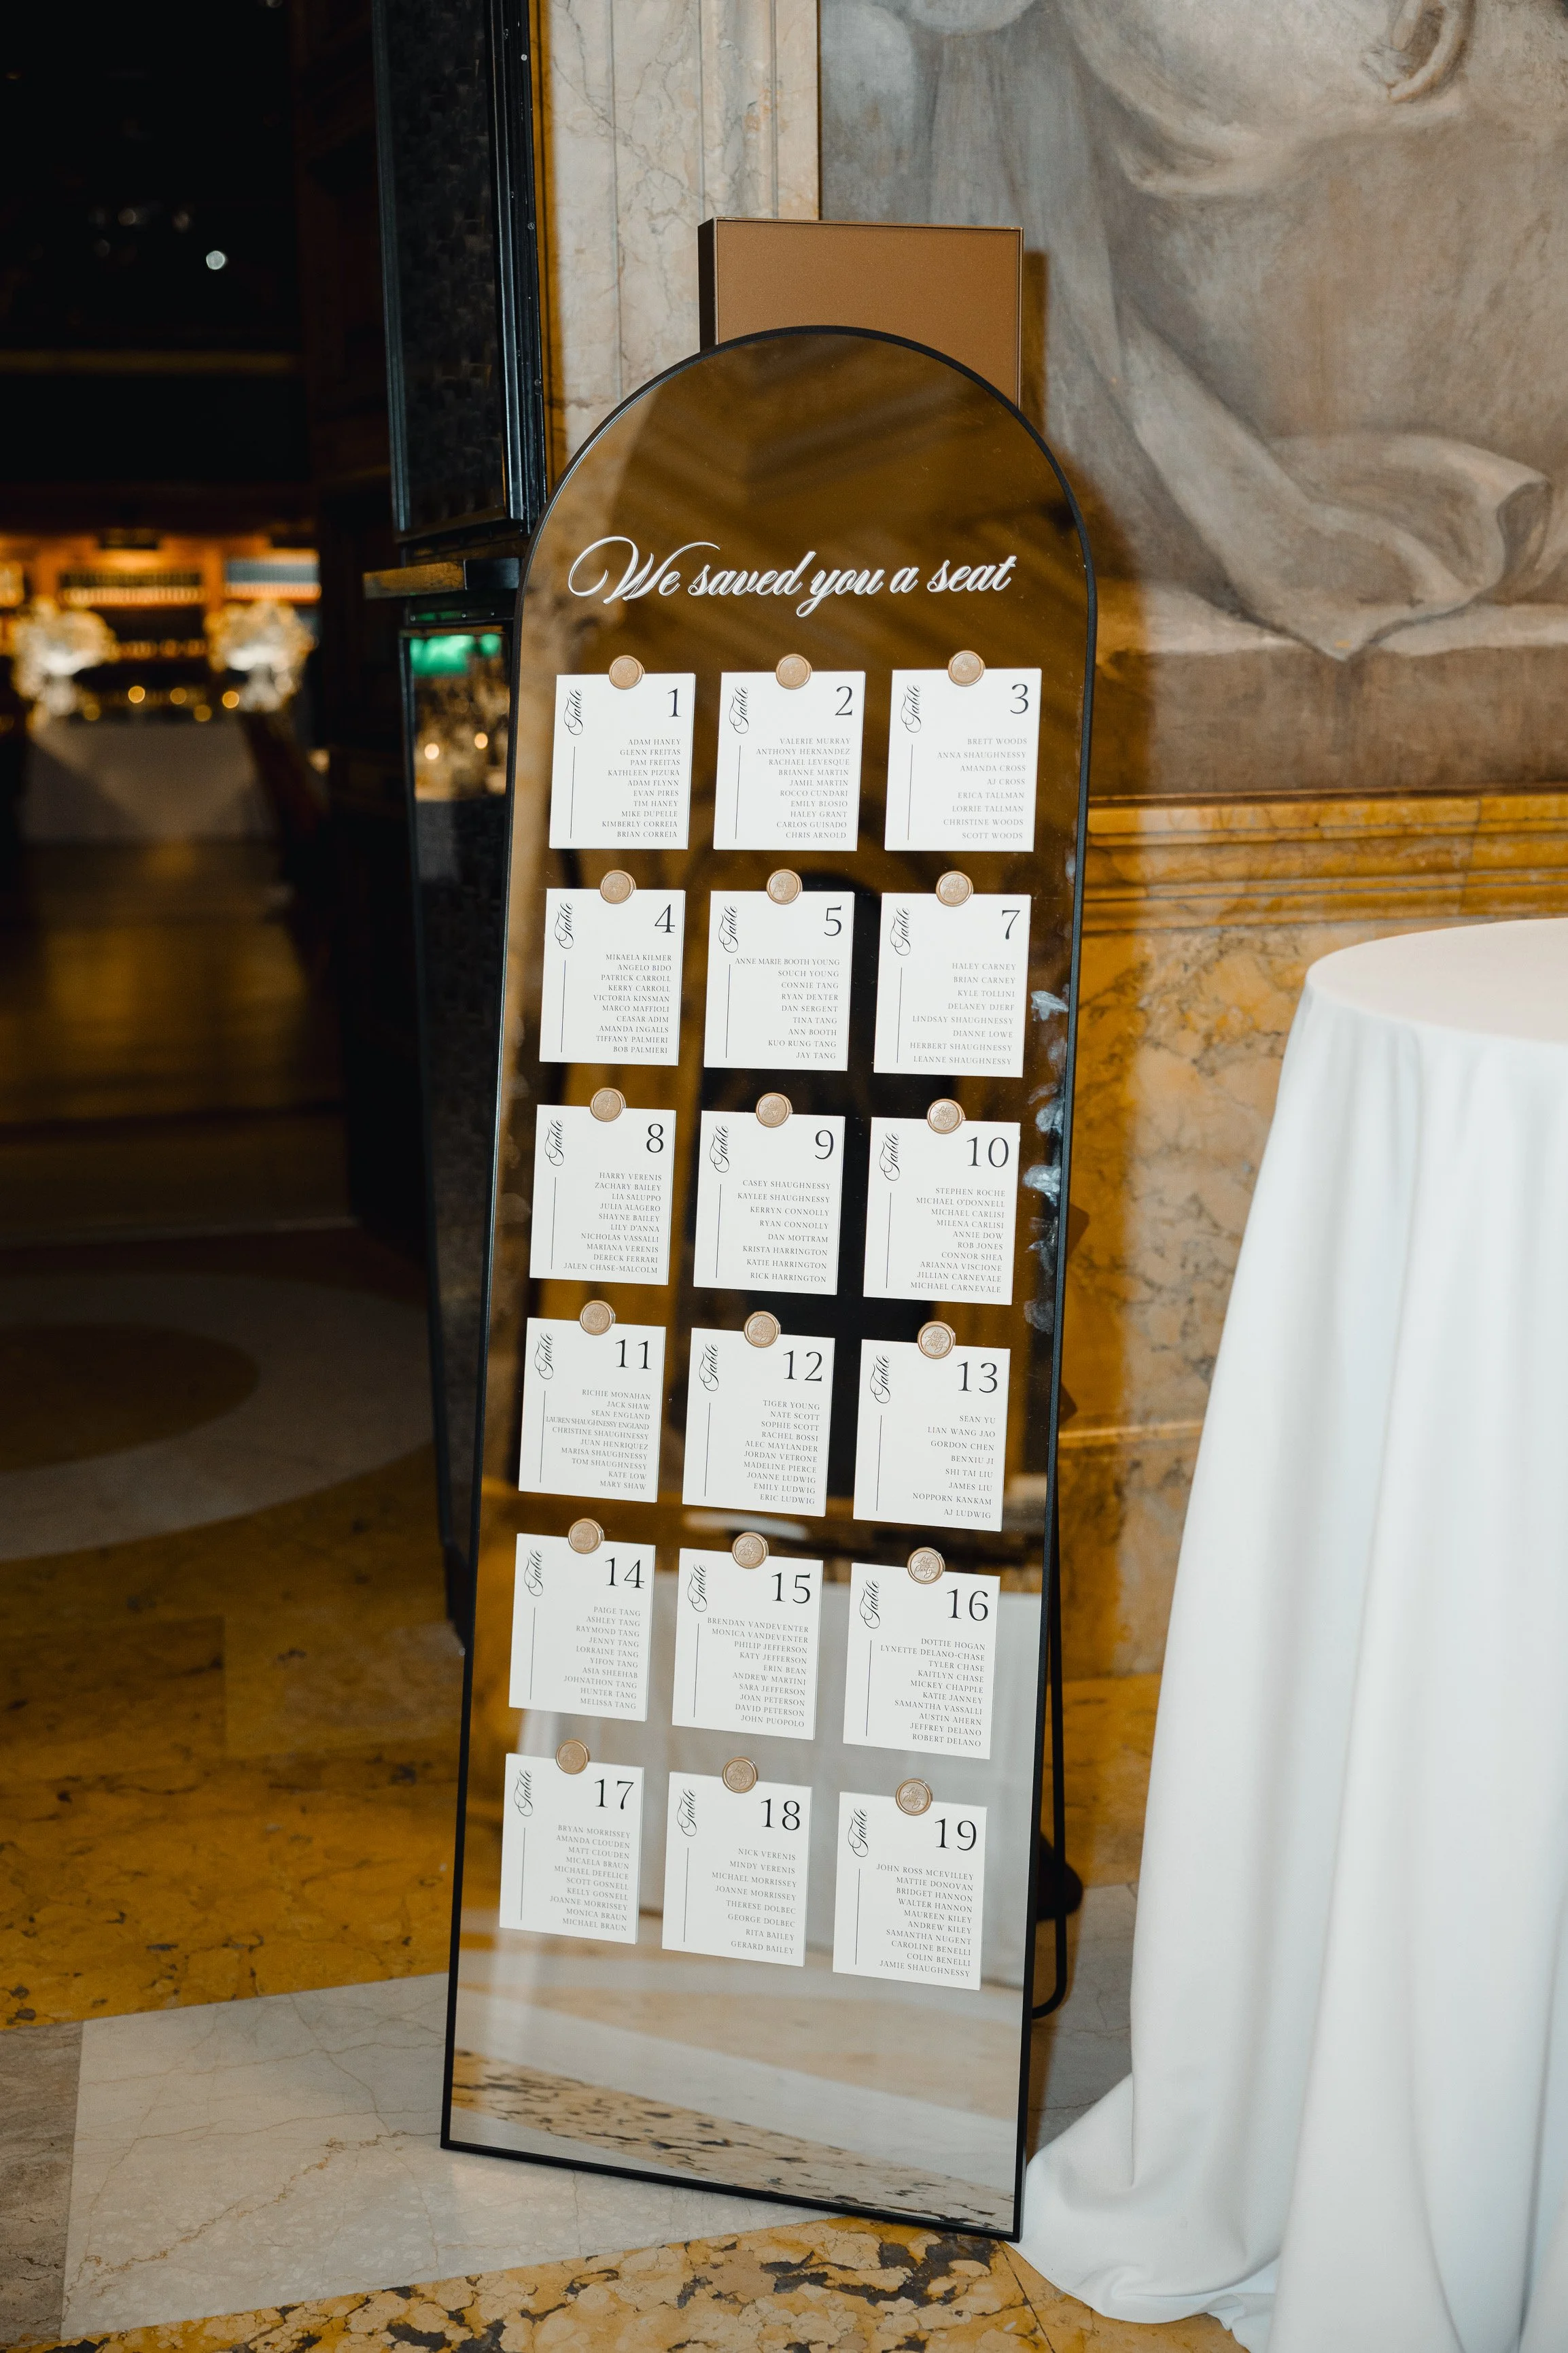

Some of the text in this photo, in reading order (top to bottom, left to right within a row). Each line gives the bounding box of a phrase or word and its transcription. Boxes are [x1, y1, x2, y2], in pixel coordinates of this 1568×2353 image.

[568, 536, 1018, 618] We saved you a seat
[667, 688, 682, 717] 1
[835, 686, 853, 716] 2
[1010, 683, 1029, 715] 3
[563, 689, 583, 736] Table
[729, 687, 749, 734] Table
[901, 685, 922, 733] Table
[995, 737, 1028, 745] WOODS
[943, 818, 1024, 826] CHRISTINE WOODS
[554, 903, 574, 949] Table
[654, 904, 676, 933] 4
[824, 905, 842, 937] 5
[1001, 910, 1021, 940] 7
[718, 906, 739, 953] Table
[890, 908, 911, 956] Table
[812, 958, 840, 966] YOUNG
[953, 976, 1015, 984] BRIAN CARNEY
[912, 1015, 1014, 1025] LINDSAY SHAUGHNESSY
[953, 1029, 1013, 1039] DIANNE LOWE
[544, 1120, 564, 1167] Table
[646, 1123, 664, 1153] 8
[815, 1129, 834, 1160] 9
[709, 1125, 730, 1173] Table
[966, 1136, 1009, 1168] 10
[879, 1133, 901, 1182] Table
[599, 1171, 662, 1182] HARRY VERENIS
[594, 1182, 661, 1192] ZACHARY BAILEY
[935, 1187, 1005, 1197] STEPHEN ROCHE
[737, 1192, 830, 1203] KAYLEE SHAUGHNESSY
[759, 1220, 829, 1230] RYAN CONNOLLY
[580, 1233, 659, 1243] NICHOLAS VASSALLI
[976, 1242, 1003, 1250] JONES
[771, 1273, 826, 1283] HARRINGTON
[910, 1281, 1001, 1293] MICHAEL CARNEVALE
[534, 1333, 554, 1380] Table
[615, 1339, 652, 1370] 11
[699, 1343, 719, 1392] Table
[783, 1350, 822, 1382] 12
[869, 1355, 891, 1404] Table
[957, 1361, 998, 1393] 13
[582, 1388, 651, 1401] RICHIE MONAHAN
[763, 1399, 820, 1411] TIGER YOUNG
[959, 1415, 996, 1424] SEAN YU
[761, 1430, 818, 1442] RACHEL BOSSI
[580, 1438, 648, 1450] JUAN HENRIQUEZ
[930, 1440, 994, 1452] GORDON CHEN
[572, 1457, 647, 1471] TOM SHAUGHNESSY
[746, 1471, 816, 1484] JOANNE LUDWIG
[912, 1492, 992, 1506] NOPPORN KANKAM
[524, 1549, 544, 1597] Table
[605, 1557, 645, 1590] 14
[687, 1564, 708, 1613] Table
[771, 1572, 811, 1604] 15
[593, 1606, 641, 1617] PAIGE TANG
[859, 1580, 880, 1629] Table
[947, 1588, 988, 1621] 16
[576, 1625, 640, 1638] RAYMOND TANG
[707, 1617, 809, 1633] BRENDAN VANDEVENTER
[921, 1638, 986, 1651] DOTTIE HOGAN
[739, 1651, 807, 1664] KATY JEFFERSON
[563, 1675, 638, 1689] JOHNATHON TANG
[918, 1669, 984, 1683] KAITLYN CHASE
[735, 1703, 805, 1717] DAVID PETERSON
[912, 1733, 981, 1747] ROBERT DELANO
[514, 1770, 534, 1817] Table
[594, 1779, 635, 1810] 17
[677, 1789, 697, 1837] Table
[761, 1798, 800, 1831] 18
[557, 1824, 631, 1839] BRYAN MORRISSEY
[848, 1808, 869, 1857] Table
[935, 1818, 977, 1851] 19
[738, 1848, 796, 1861] NICK VERENIS
[565, 1876, 629, 1891] SCOTT GOSNELL
[896, 1887, 973, 1902] BRIDGET HANNON
[727, 1913, 796, 1928] GEORGE DOLBEC
[904, 1909, 972, 1924] MAUREEN KILEY
[886, 1929, 972, 1945] SAMANTHA NUGENT
[731, 1940, 795, 1955] GERARD BAILEY
